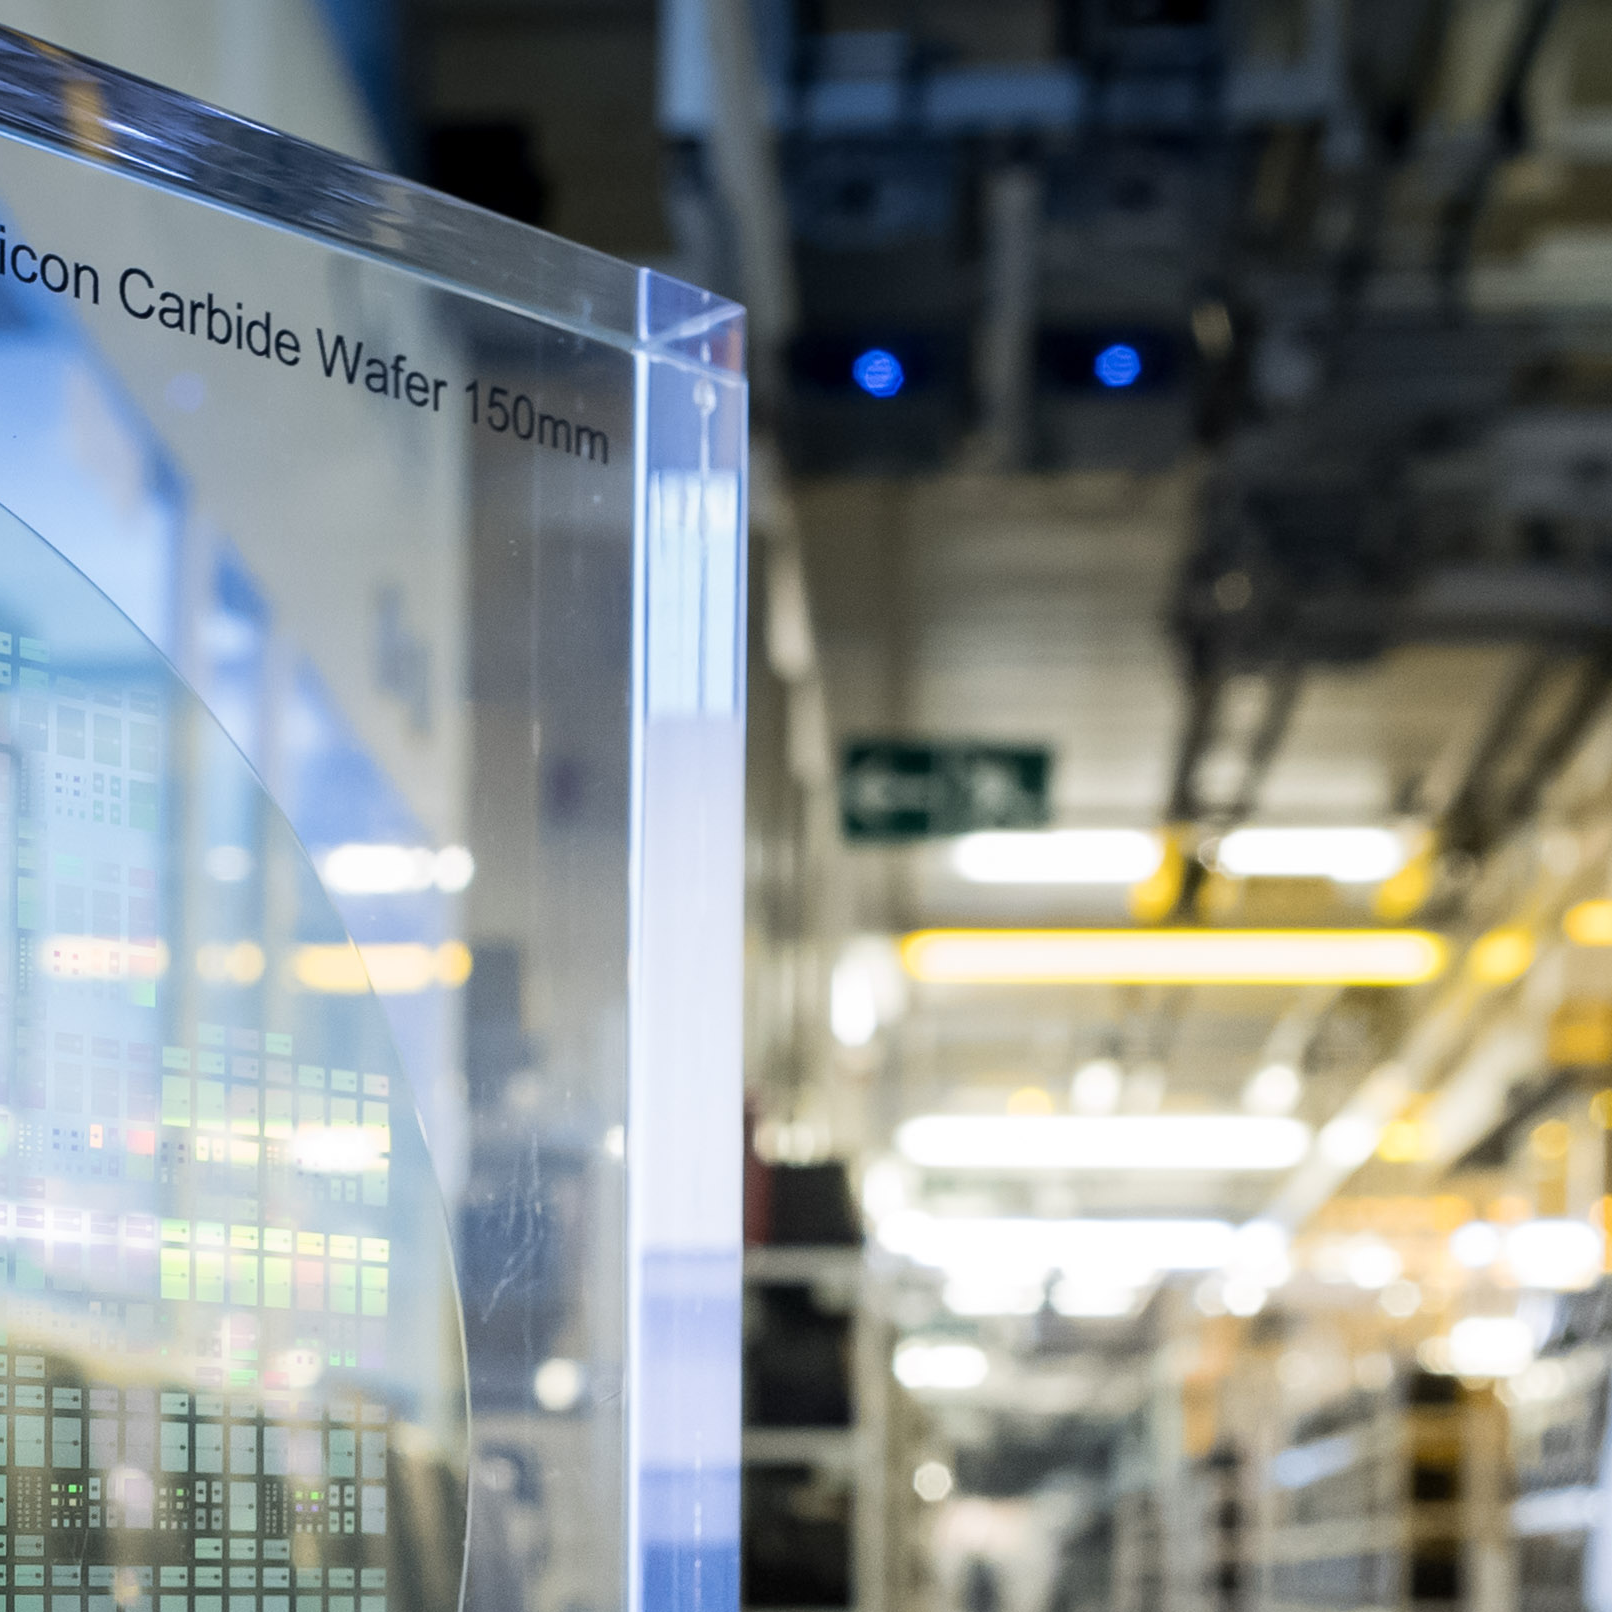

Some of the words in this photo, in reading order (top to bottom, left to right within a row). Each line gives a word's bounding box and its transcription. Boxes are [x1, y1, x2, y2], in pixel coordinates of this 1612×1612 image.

[119, 267, 302, 367] Carbide
[316, 328, 447, 412] Wafer
[464, 380, 610, 464] 150mm
